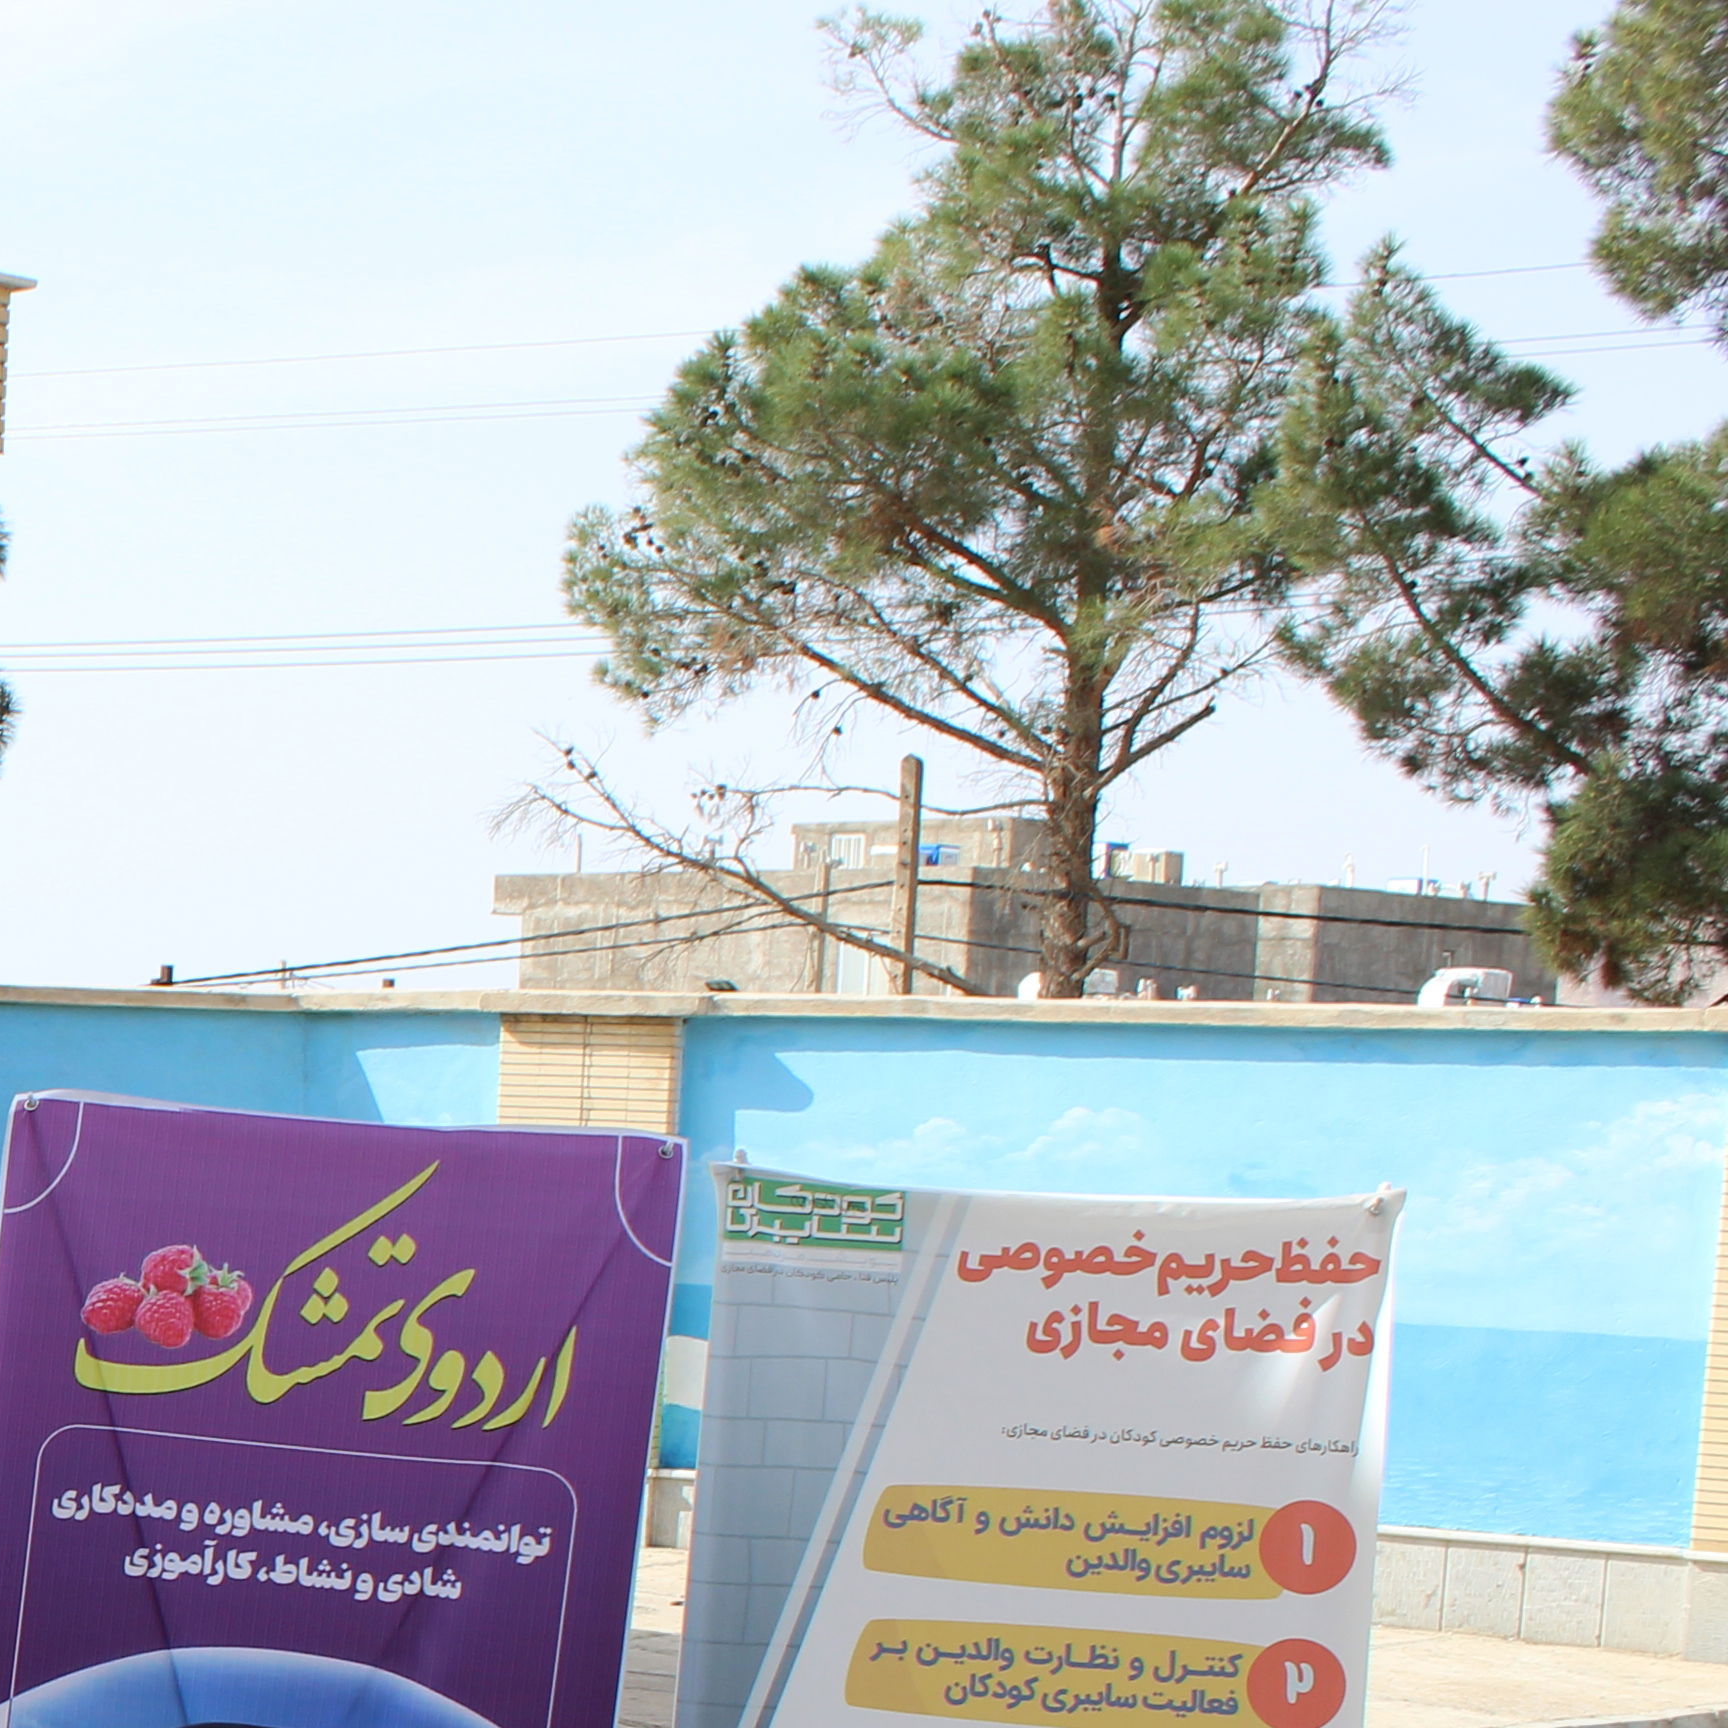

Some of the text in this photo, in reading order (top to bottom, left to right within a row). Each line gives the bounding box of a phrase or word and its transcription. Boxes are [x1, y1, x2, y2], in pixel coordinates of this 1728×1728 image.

[957, 1229, 1158, 1290] خصوصی
[1157, 1246, 1276, 1297] حریم
[1274, 1235, 1382, 1285] حفظ
[74, 1160, 577, 1431] اردوی تمشک
[1026, 1296, 1375, 1372] در فضای مجازی
[1050, 1424, 1089, 1442] فضای
[1089, 1430, 1108, 1445] در
[1108, 1427, 1157, 1447] کودکان
[1158, 1433, 1219, 1450] خصوصی
[1221, 1436, 1257, 1453] حریم
[1260, 1436, 1293, 1452] حفظ
[1294, 1437, 1360, 1459] راهکارهای
[51, 1482, 178, 1520] مددکاری
[179, 1504, 199, 1531] و
[203, 1499, 314, 1537] مشاوره
[882, 1496, 967, 1529] آگاهی
[974, 1513, 990, 1534] و
[998, 1505, 1075, 1537] دانش
[1199, 1518, 1255, 1551] لزوم
[412, 1519, 553, 1564] توانمندی
[123, 1539, 258, 1586] کارآموزی
[1065, 1548, 1252, 1585] سایبری والدین
[355, 1574, 373, 1600] و
[377, 1566, 462, 1602] شادی
[869, 1637, 1243, 1684] کنترل و نظارت والدین بر
[944, 1673, 1240, 1719] فعالیت سایبری کودکان
